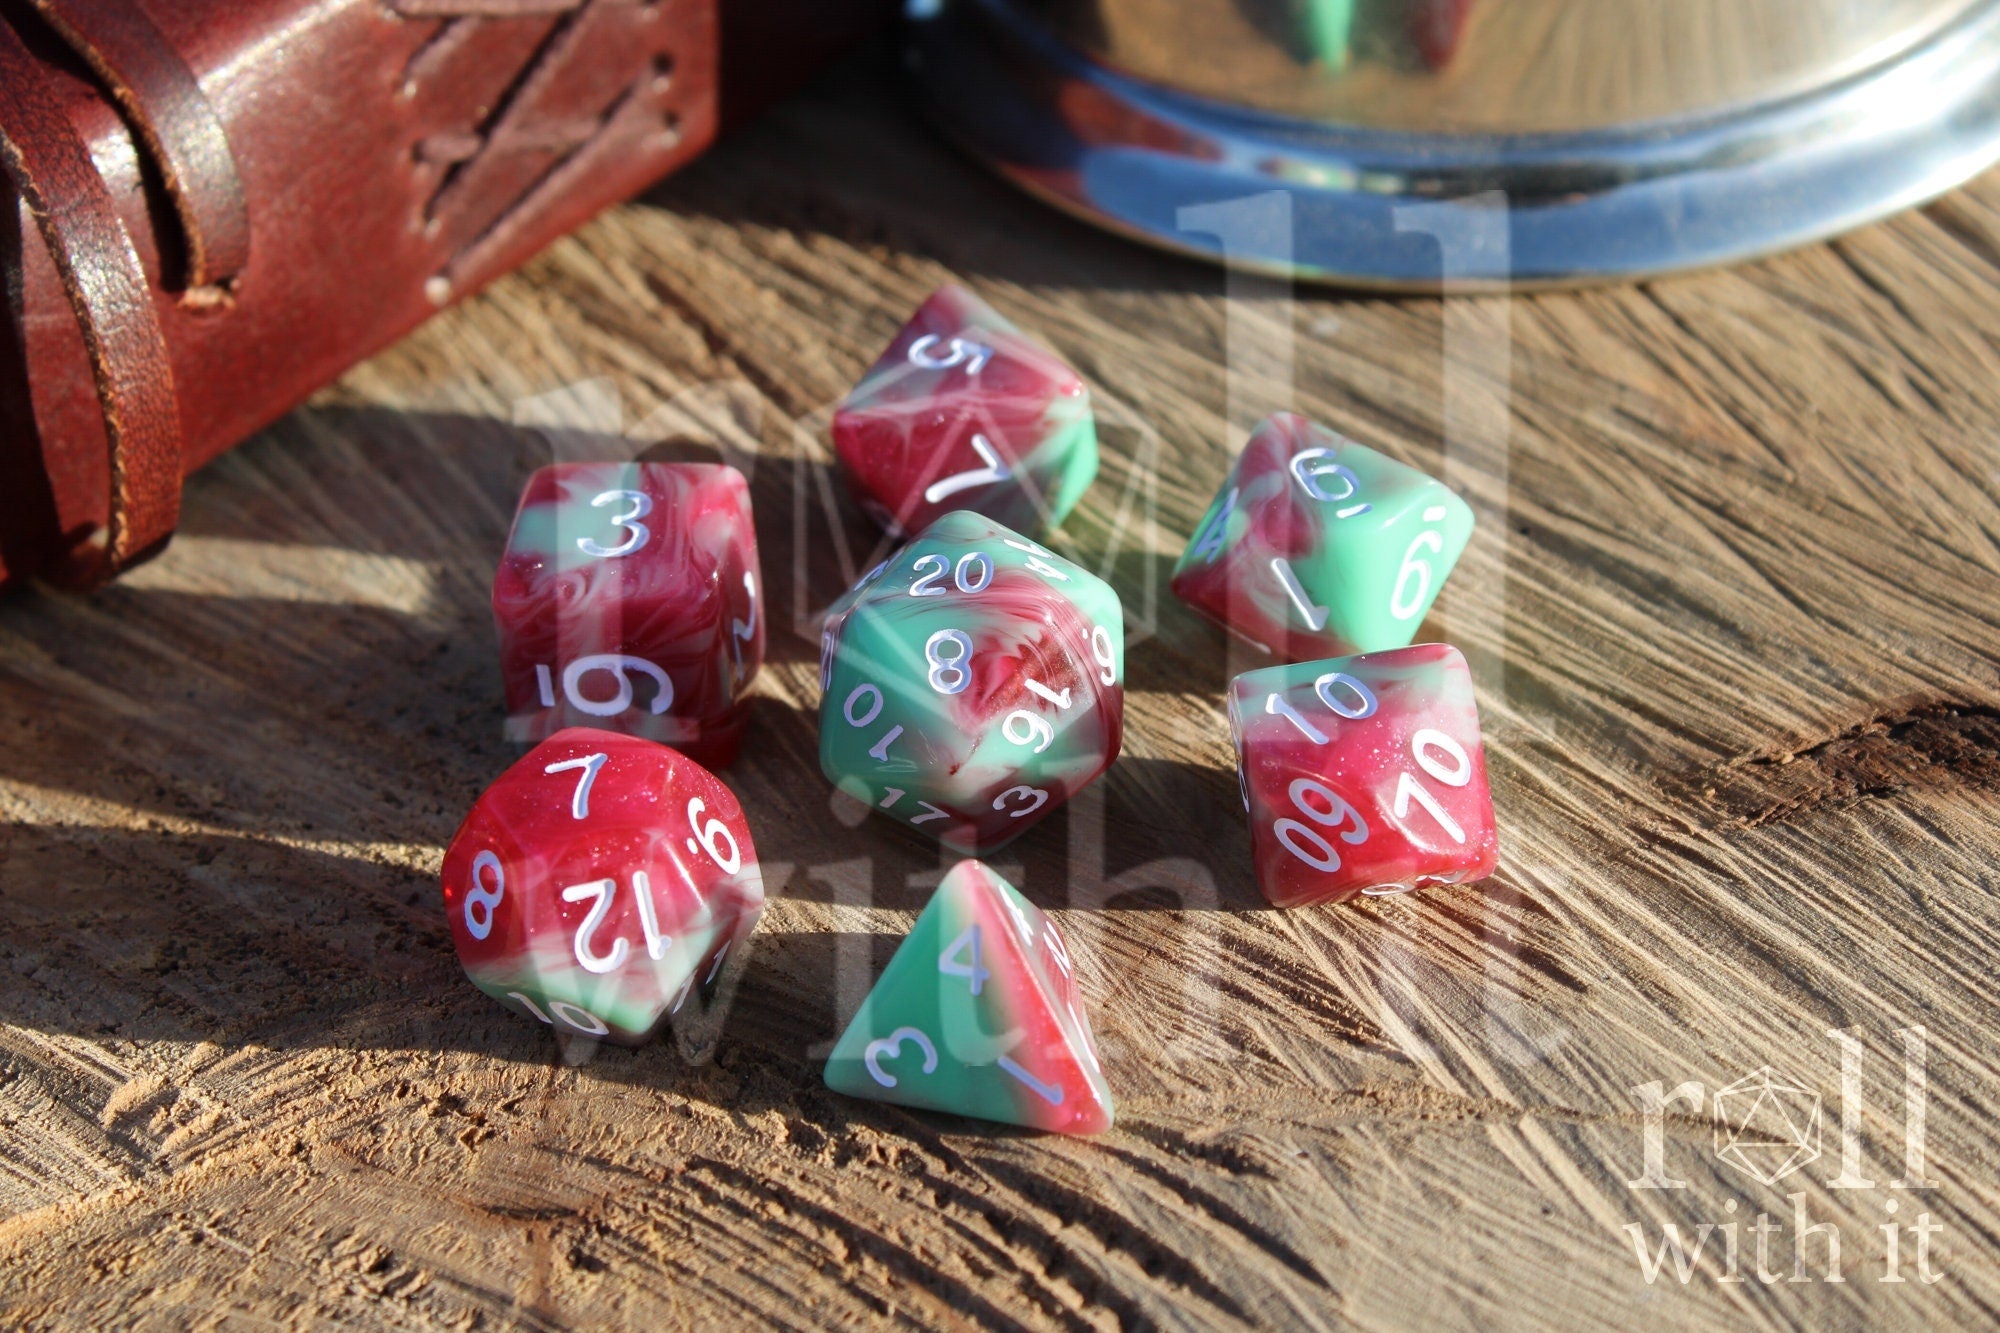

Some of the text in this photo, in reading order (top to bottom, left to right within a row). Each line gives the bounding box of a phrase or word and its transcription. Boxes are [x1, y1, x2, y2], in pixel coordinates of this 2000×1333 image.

[908, 333, 994, 376] 5
[925, 433, 1011, 504] 7
[576, 489, 653, 558] 3
[909, 551, 995, 597] 20
[1271, 557, 1330, 631] 1
[925, 628, 974, 694] 8
[843, 683, 904, 762] 10
[1001, 677, 1072, 754] 16
[1265, 672, 1378, 745] 10
[544, 752, 608, 820] 7
[878, 786, 951, 824] 17
[993, 785, 1049, 818] 3
[1394, 728, 1472, 844] 70
[464, 850, 505, 940] 8
[562, 870, 673, 974] 12
[938, 923, 990, 996] 4
[507, 991, 610, 1036] 10
[865, 1026, 939, 1088] 3
[998, 1056, 1065, 1106] 1
